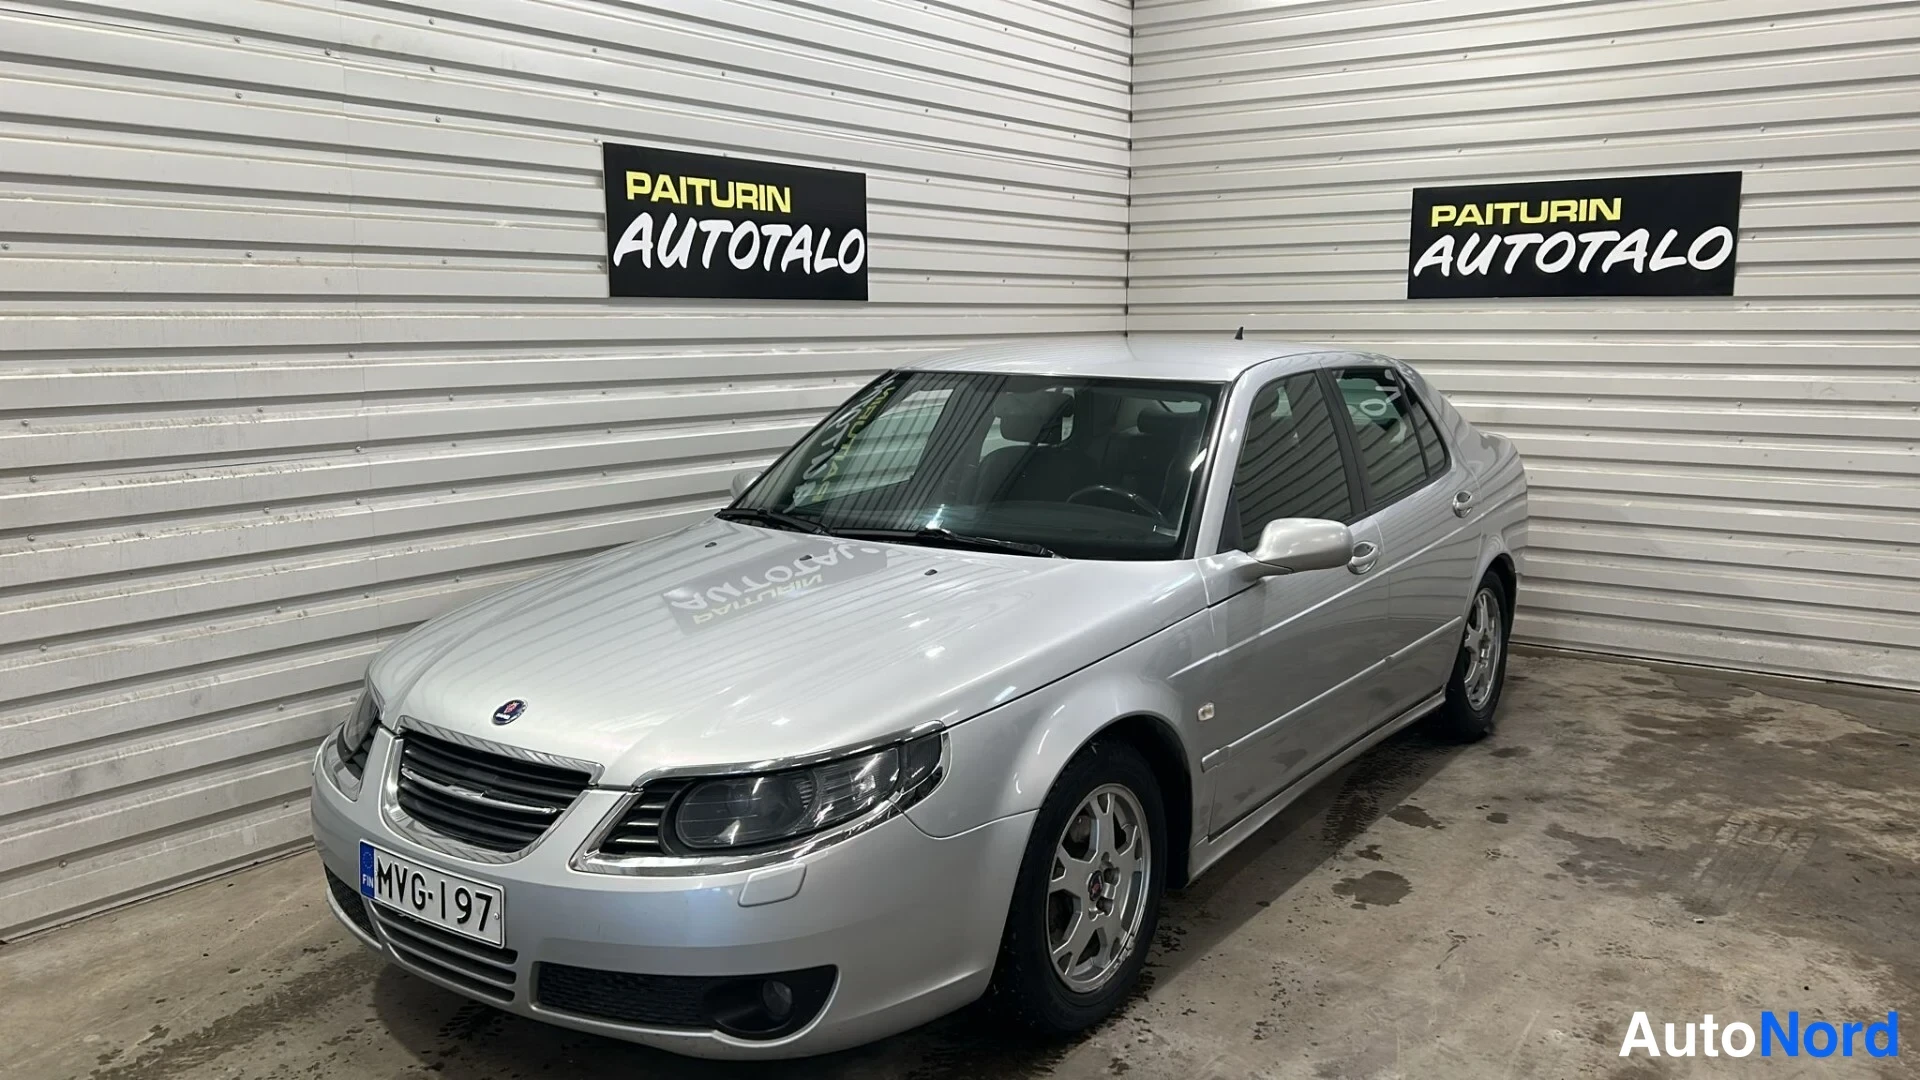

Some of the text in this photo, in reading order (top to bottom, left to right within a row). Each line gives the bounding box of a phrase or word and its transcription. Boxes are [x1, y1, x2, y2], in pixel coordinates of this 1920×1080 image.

[626, 170, 791, 213] PAITURIN
[1431, 197, 1622, 227] PAITURIN
[613, 211, 865, 275] AUTOTALO
[1413, 225, 1734, 277] AUTOTALO
[362, 873, 374, 889] FIN
[377, 858, 493, 932] MVG-197
